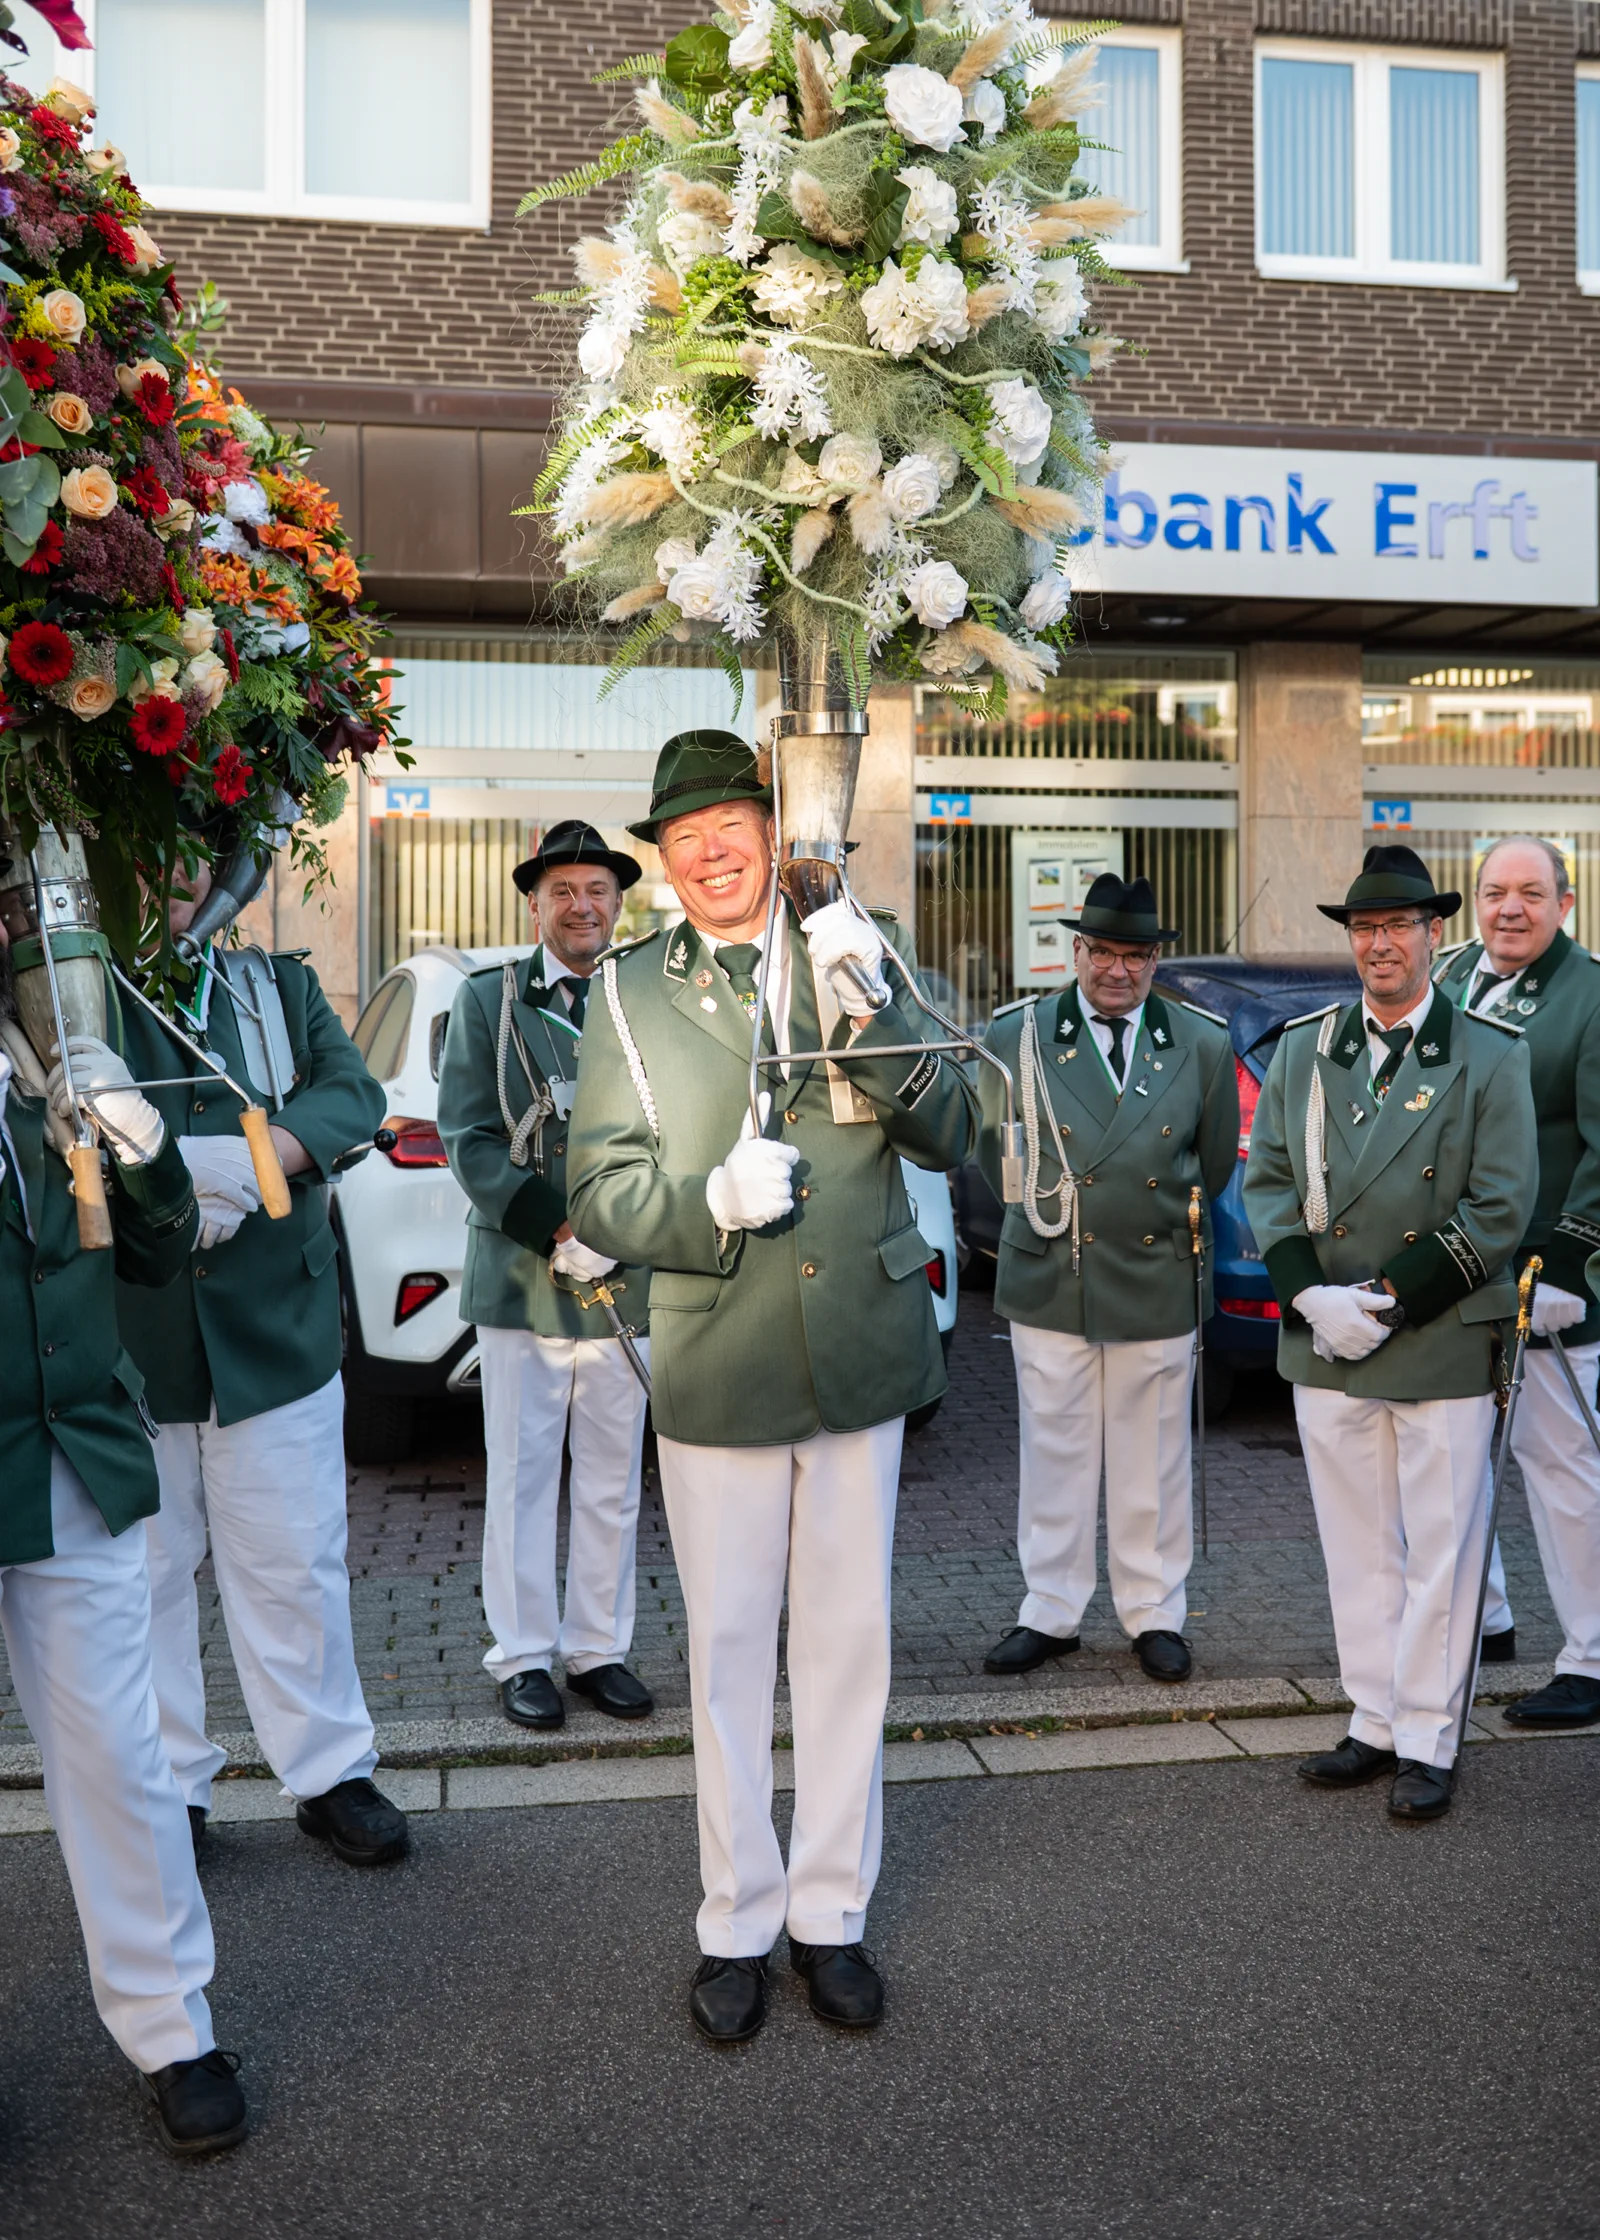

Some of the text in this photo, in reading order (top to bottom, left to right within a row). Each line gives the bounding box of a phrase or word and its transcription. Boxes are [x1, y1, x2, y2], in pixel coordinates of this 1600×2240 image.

[1067, 470, 1539, 562] bank Erft
[1038, 840, 1098, 850] Immobilien
